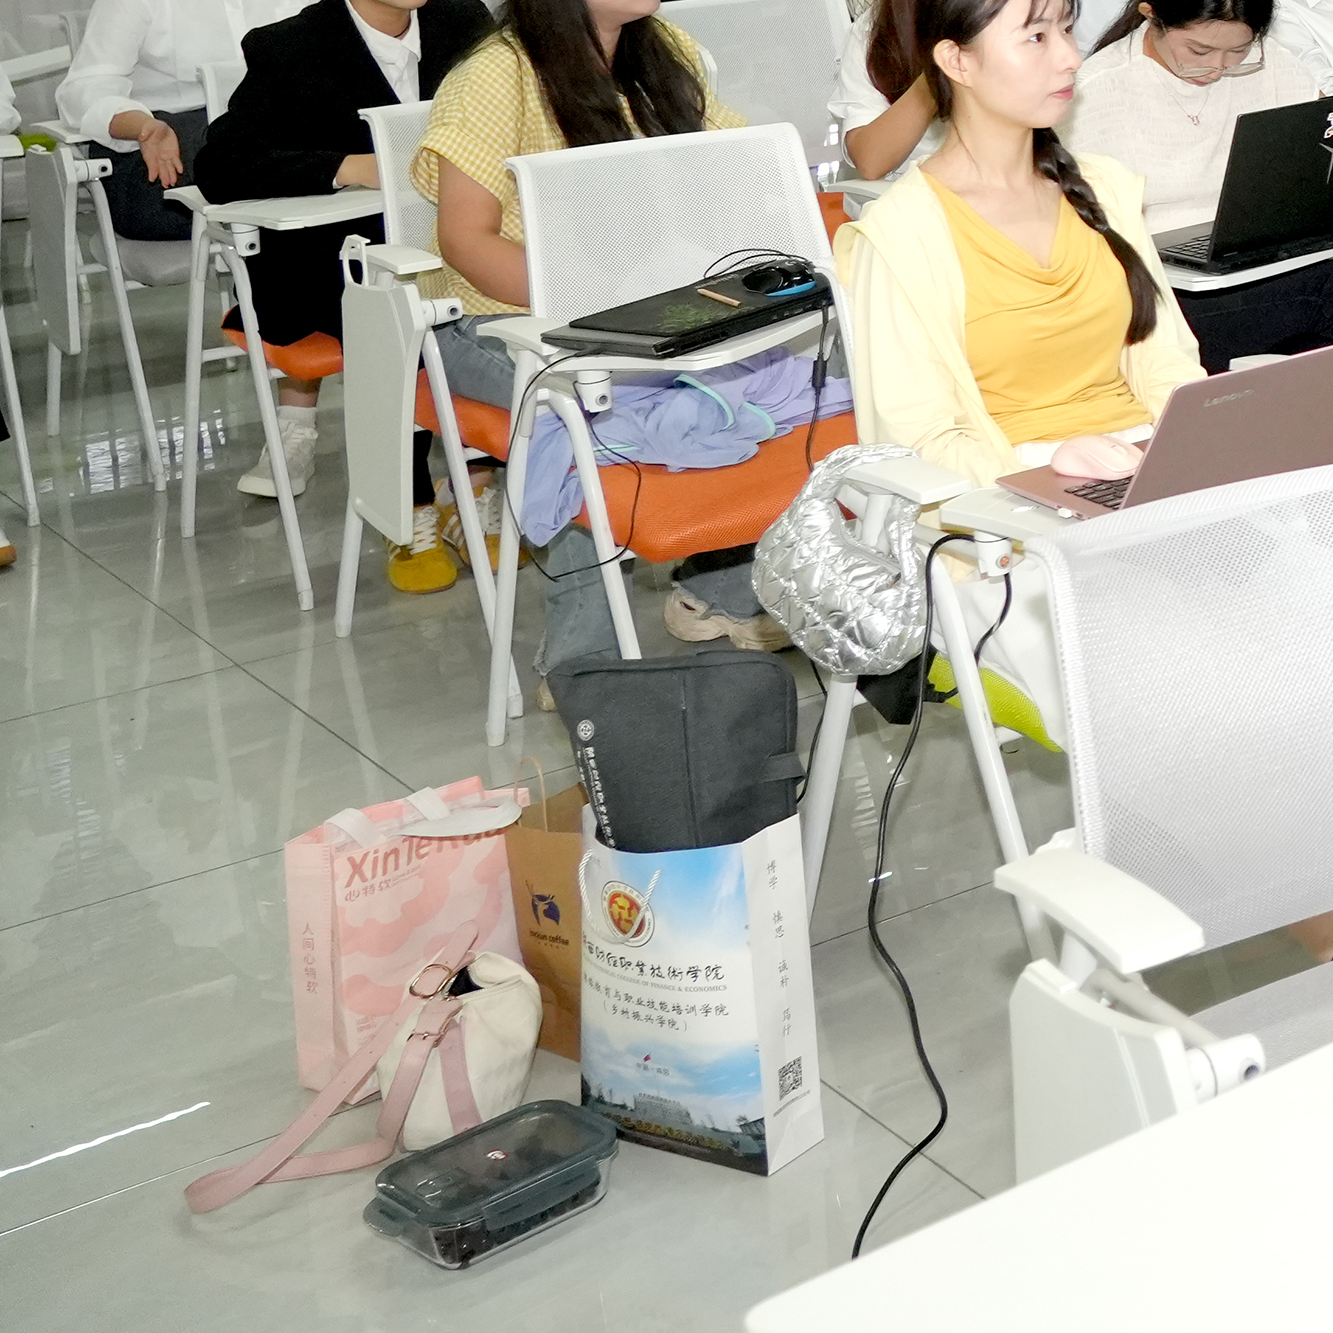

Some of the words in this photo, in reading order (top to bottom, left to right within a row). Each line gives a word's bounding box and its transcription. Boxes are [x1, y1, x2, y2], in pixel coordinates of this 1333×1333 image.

[302, 922, 319, 995] 人间心特软
